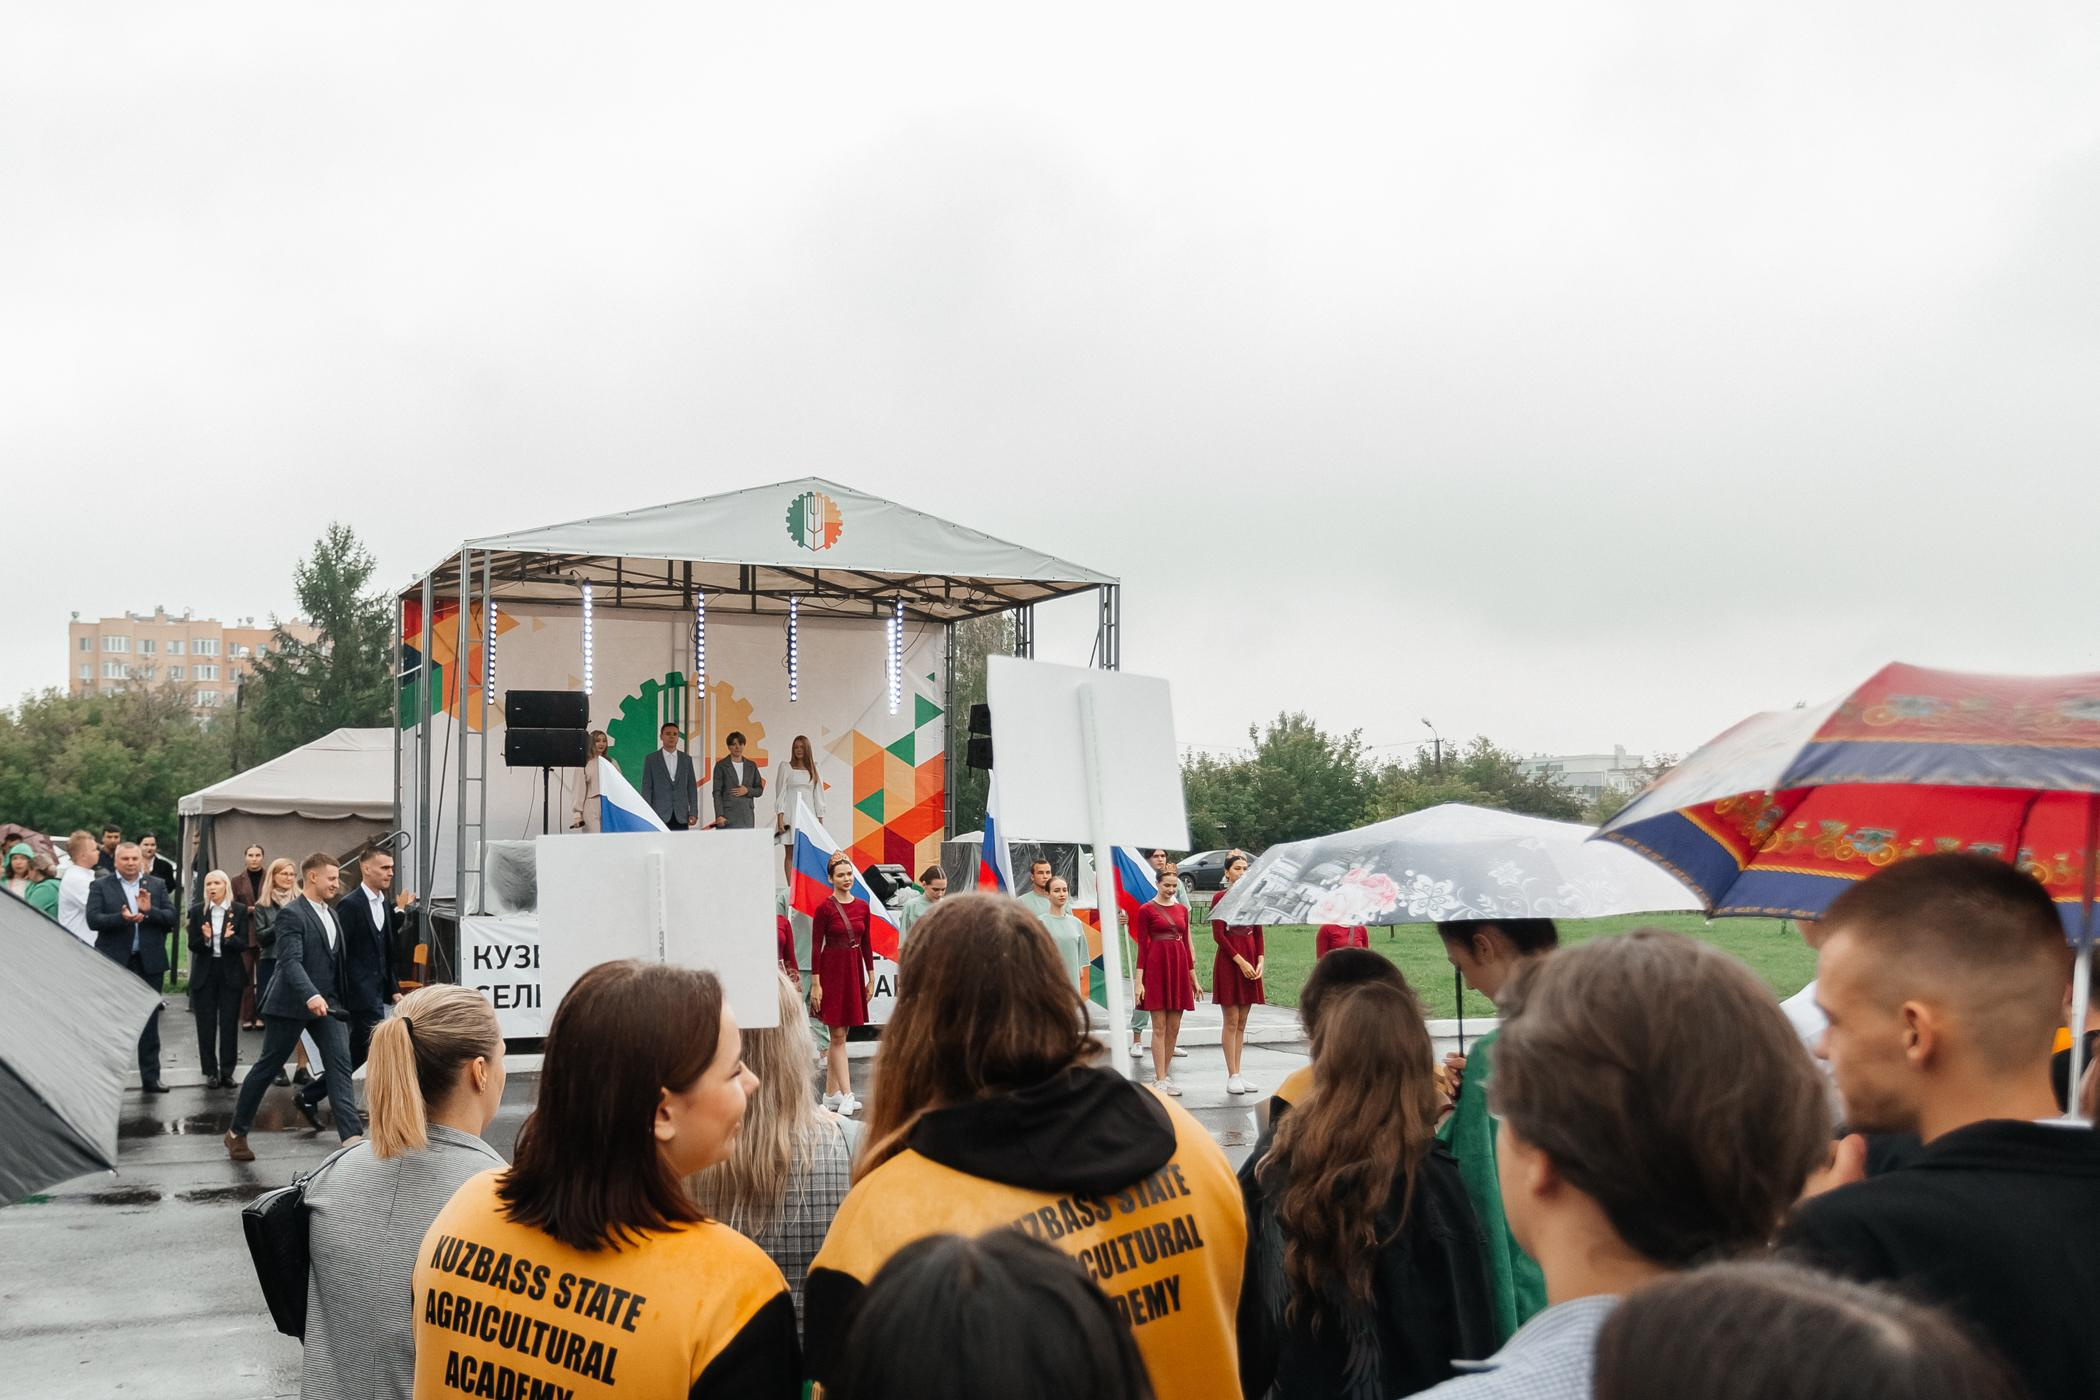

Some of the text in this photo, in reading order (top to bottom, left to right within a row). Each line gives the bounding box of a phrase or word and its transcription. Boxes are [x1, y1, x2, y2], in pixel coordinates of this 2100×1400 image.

[430, 1235, 647, 1334] KUZBASS STATE
[1074, 1213, 1205, 1283] CULTURAL
[425, 1288, 618, 1387] AGRICULTURAL
[1111, 1274, 1181, 1330] DEMY
